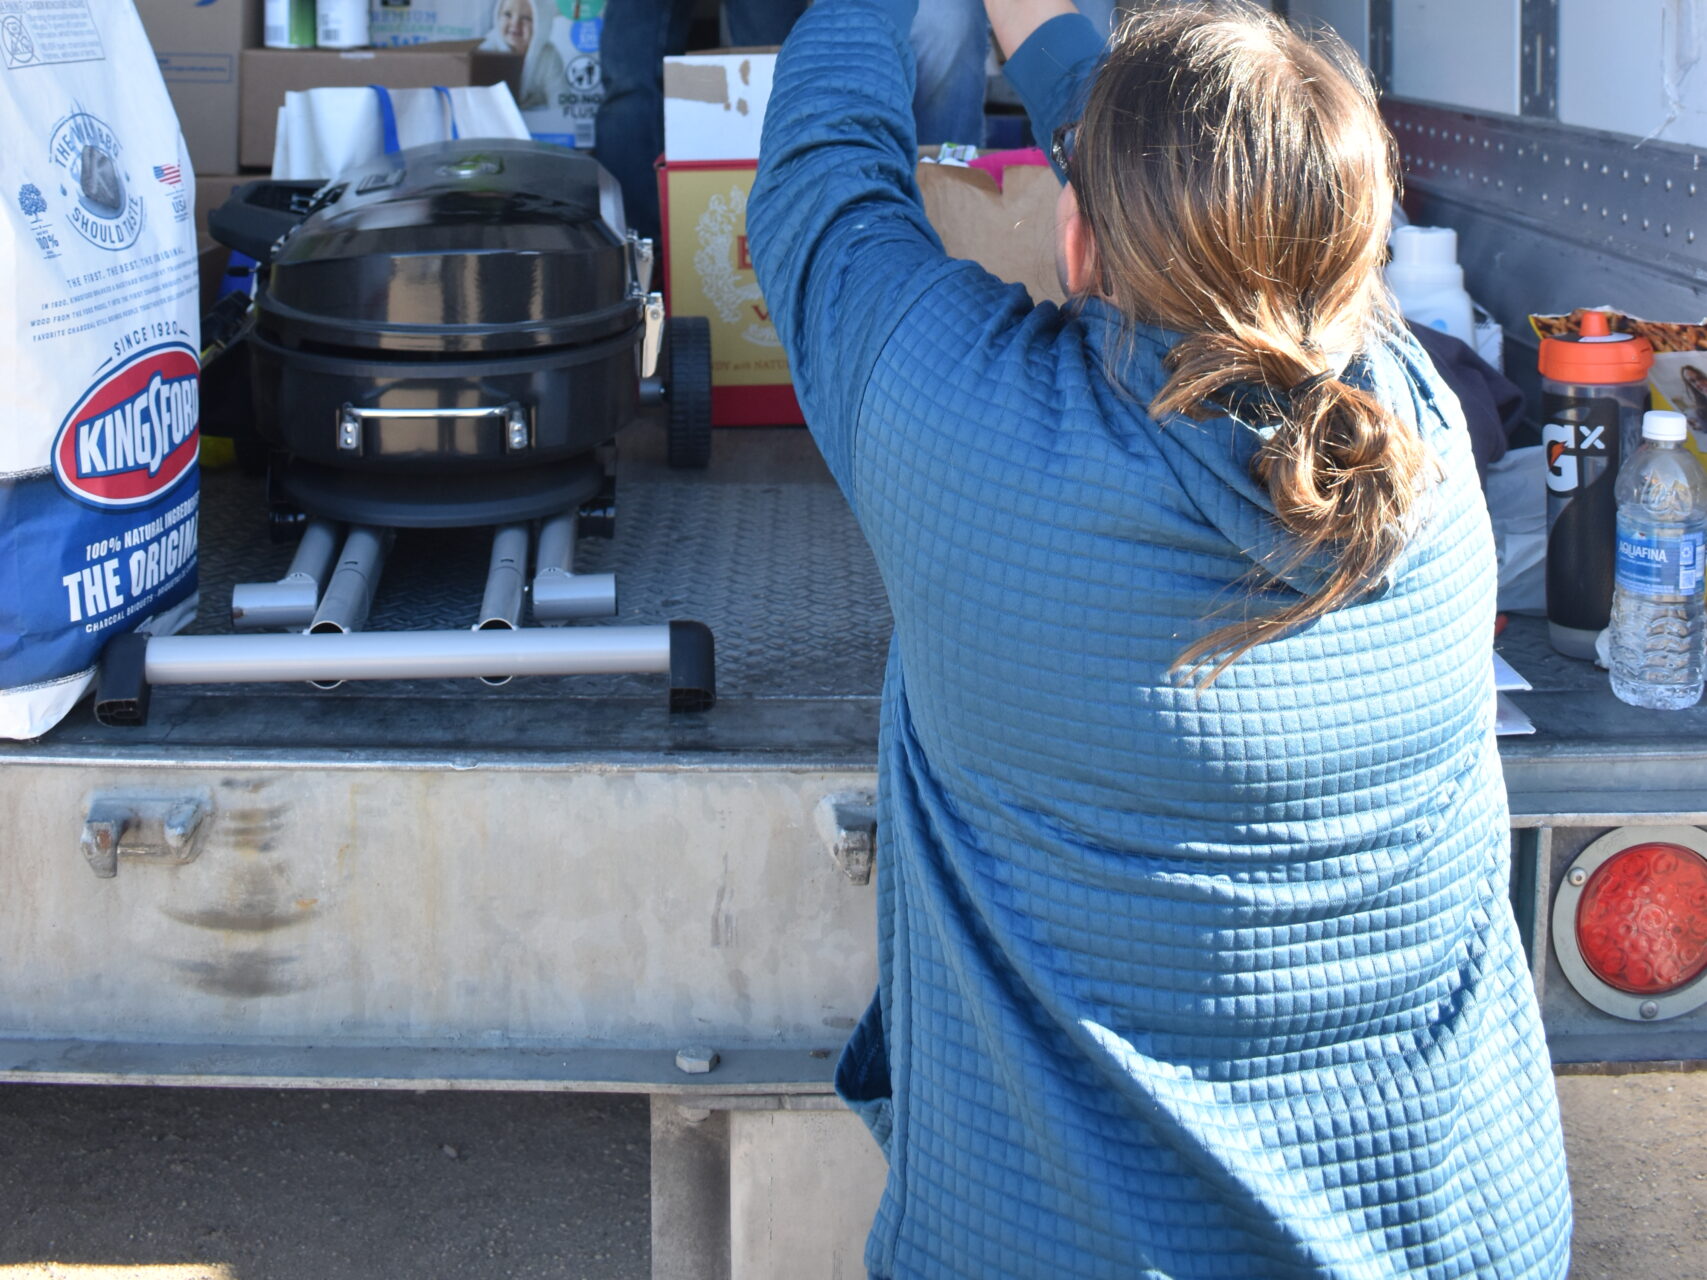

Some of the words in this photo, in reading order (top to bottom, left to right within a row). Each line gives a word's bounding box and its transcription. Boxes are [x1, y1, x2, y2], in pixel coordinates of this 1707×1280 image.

[72, 207, 125, 243] SHOULD
[113, 327, 148, 356] SINCE
[151, 320, 178, 339] 1920
[80, 375, 199, 474] KINGSFORD
[85, 536, 122, 561] 100%
[124, 516, 164, 549] NATURAL
[1619, 540, 1669, 563] AQUAFINA
[62, 558, 124, 623] THE
[129, 510, 199, 598] ORIGINA
[85, 610, 125, 633] CHARCOAL
